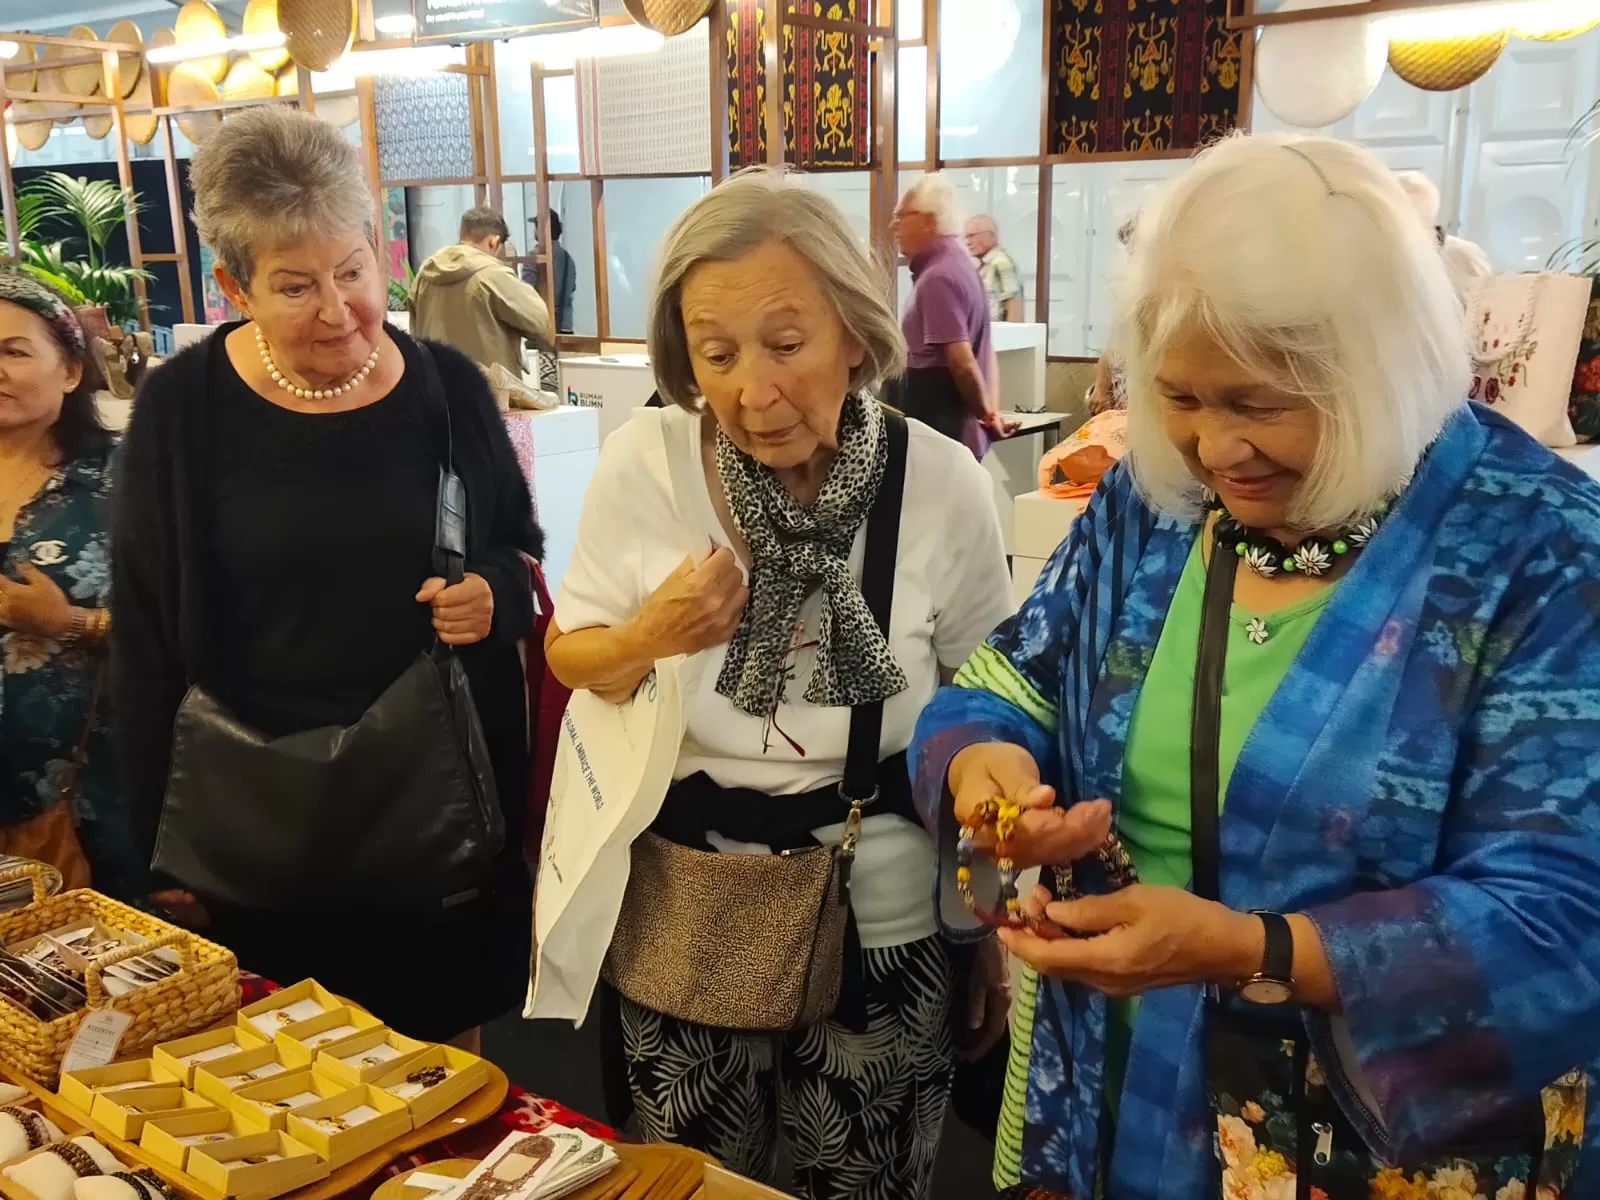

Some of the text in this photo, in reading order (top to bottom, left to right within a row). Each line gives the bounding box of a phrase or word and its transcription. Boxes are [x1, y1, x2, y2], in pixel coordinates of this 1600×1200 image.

[579, 399, 604, 408] BUMN
[585, 770, 597, 788] THE
[591, 784, 605, 811] WORLD
